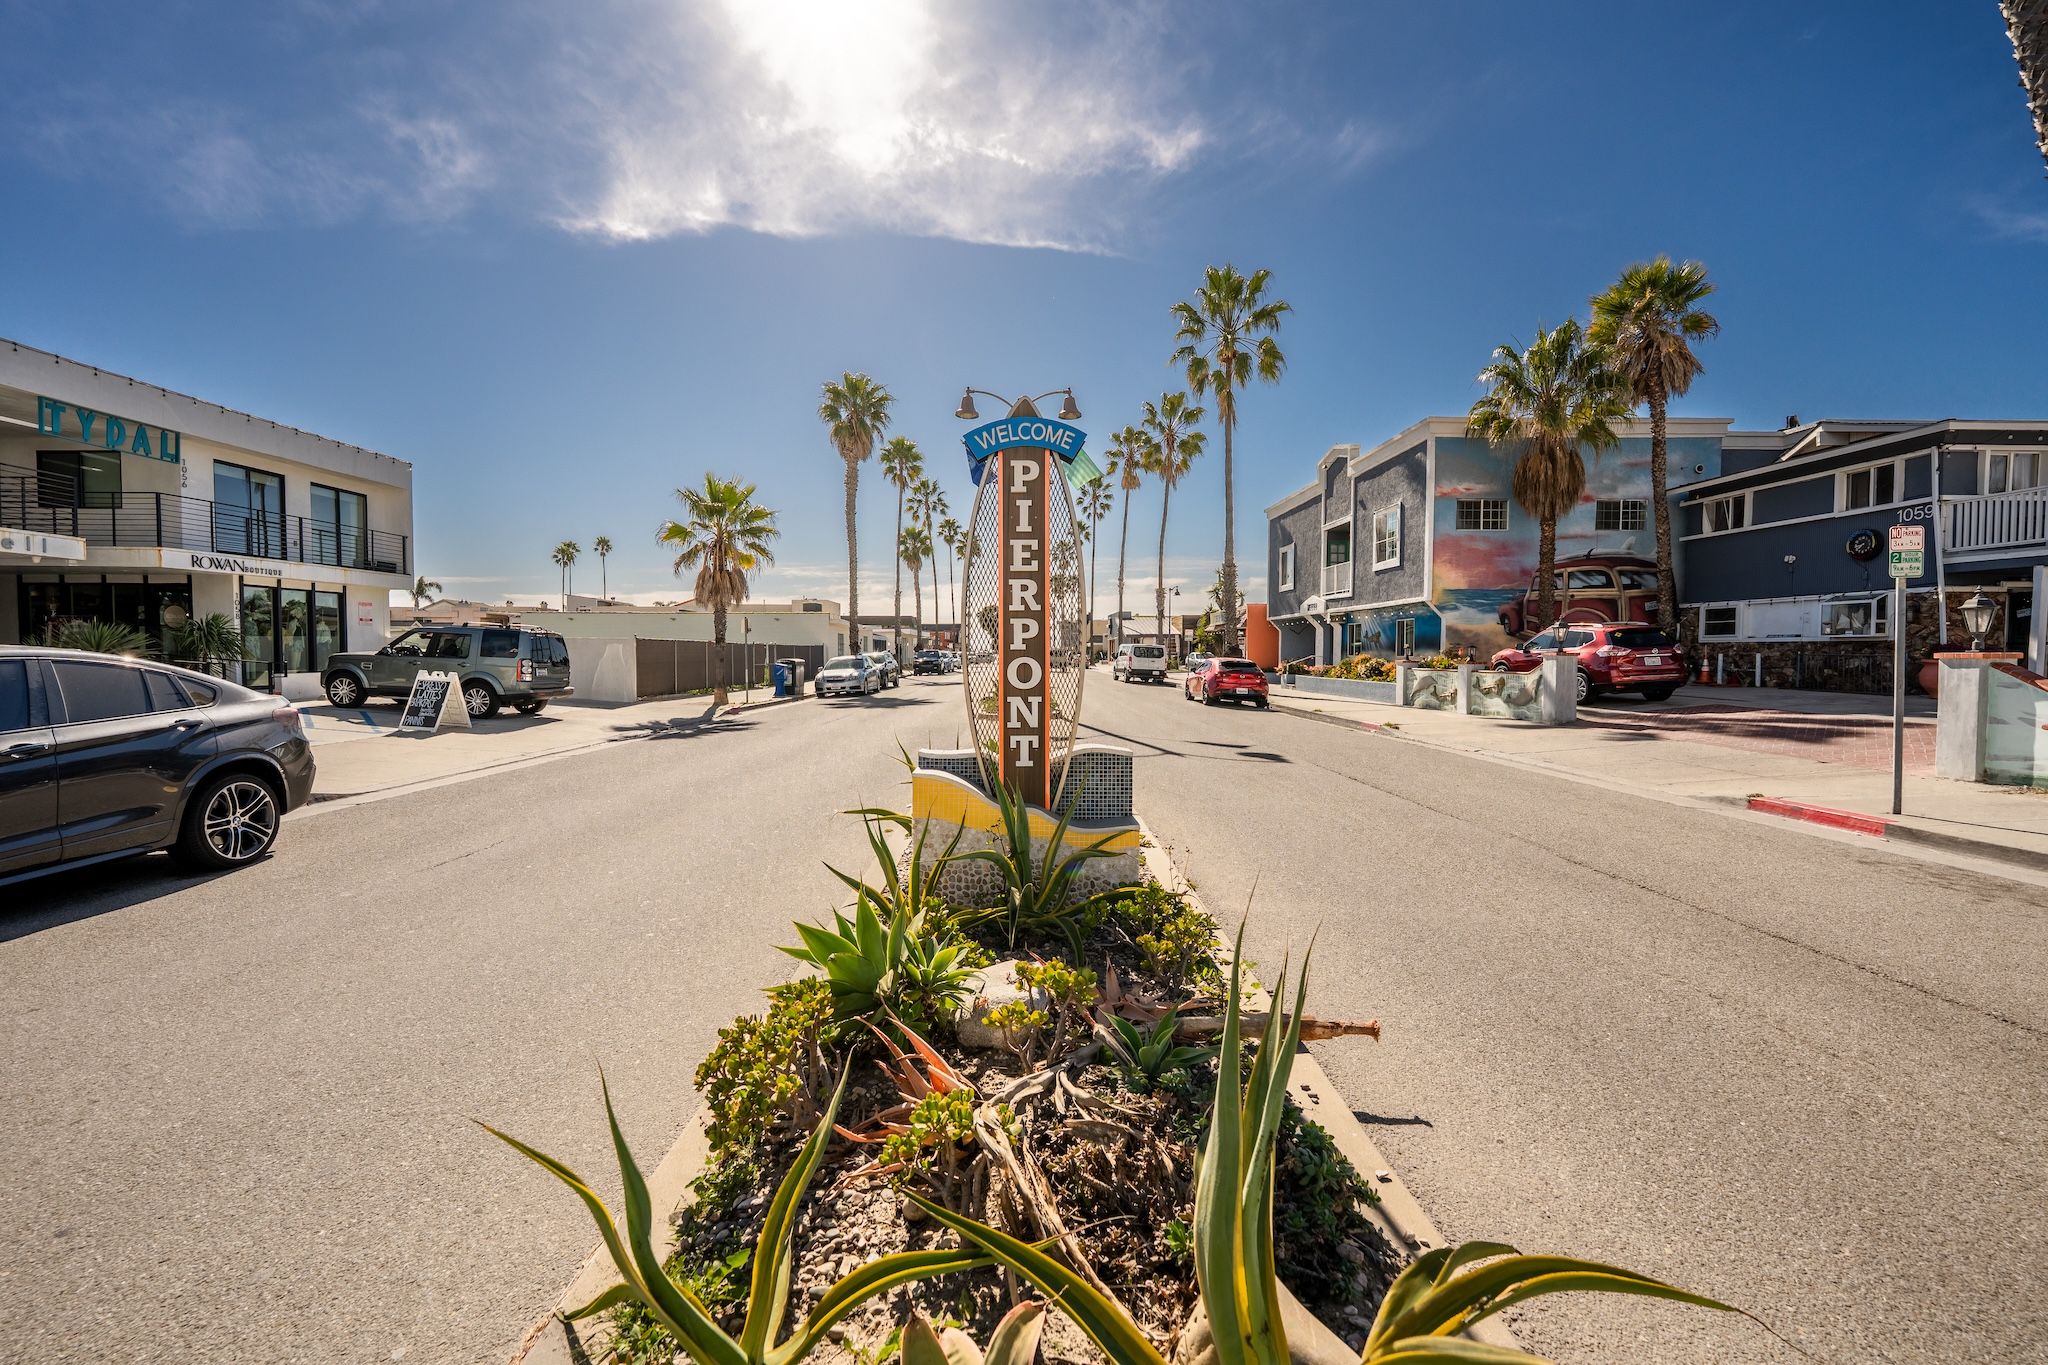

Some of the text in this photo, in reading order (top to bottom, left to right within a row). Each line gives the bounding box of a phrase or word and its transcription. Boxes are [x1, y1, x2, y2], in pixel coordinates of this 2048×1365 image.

[45, 400, 177, 463] TYDAL
[974, 422, 1076, 449] WELCOME
[1897, 504, 1933, 523] 1059
[1892, 528, 1901, 538] NO
[191, 554, 283, 576] ROWAN BOUTIQUE
[1892, 552, 1899, 563] 2
[1007, 460, 1042, 767] PIERPONT
[417, 689, 443, 700] LATTES
